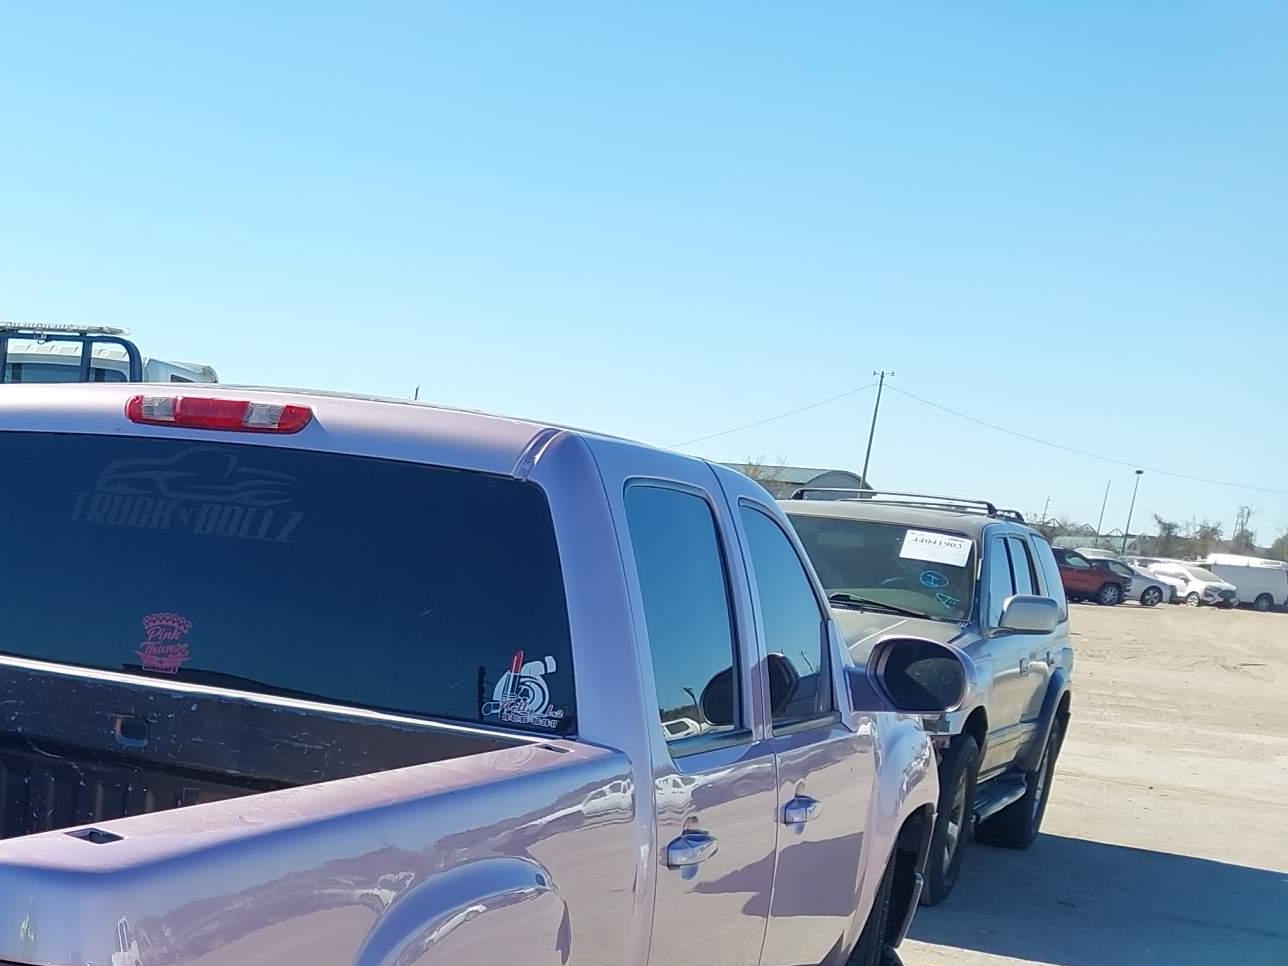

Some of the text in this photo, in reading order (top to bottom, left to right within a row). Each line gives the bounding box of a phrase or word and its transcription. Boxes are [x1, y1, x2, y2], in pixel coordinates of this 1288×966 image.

[71, 491, 179, 530] TRUCK
[193, 503, 305, 544] DOLLZ
[146, 626, 183, 642] Pink
